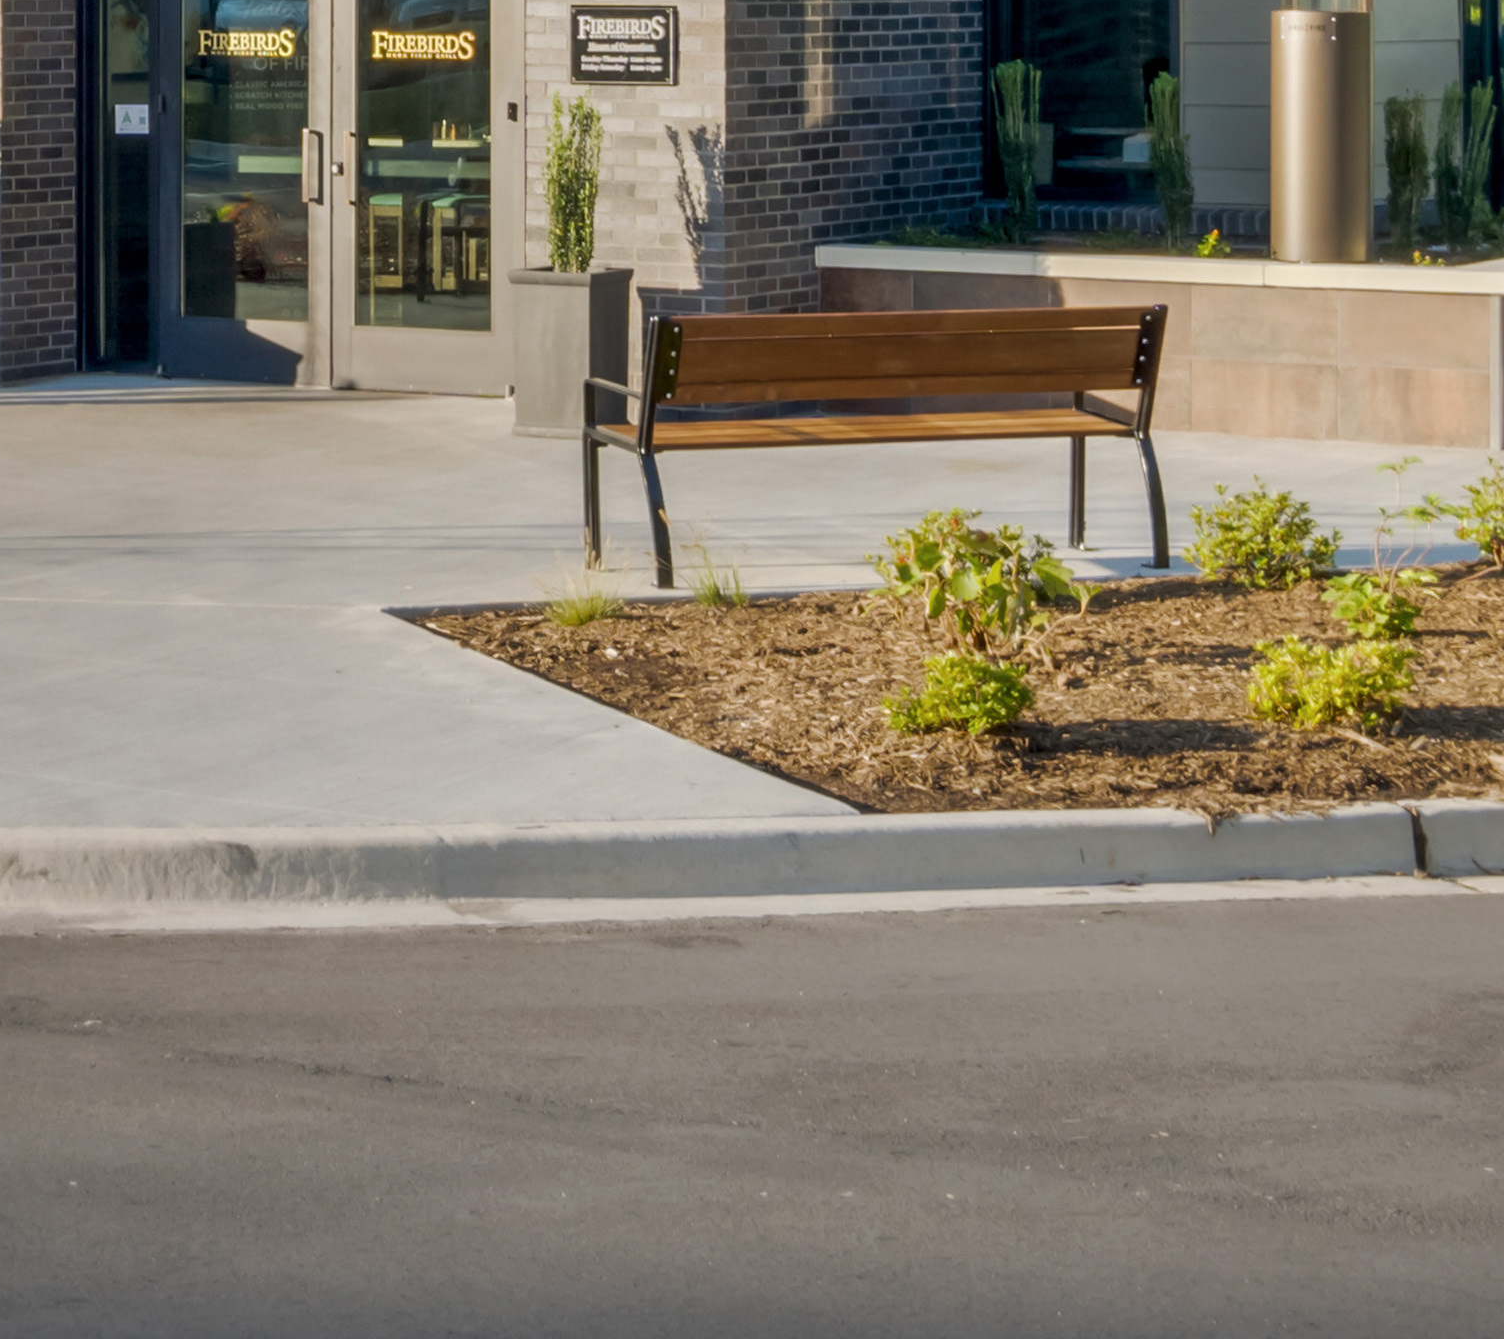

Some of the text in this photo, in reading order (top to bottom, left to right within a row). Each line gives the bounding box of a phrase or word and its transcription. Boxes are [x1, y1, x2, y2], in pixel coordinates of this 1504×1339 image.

[576, 15, 667, 40] FIREBIRDS
[198, 29, 295, 57] FIREBIRDS
[371, 30, 476, 59] FIREBIRDS
[253, 57, 278, 71] OF
